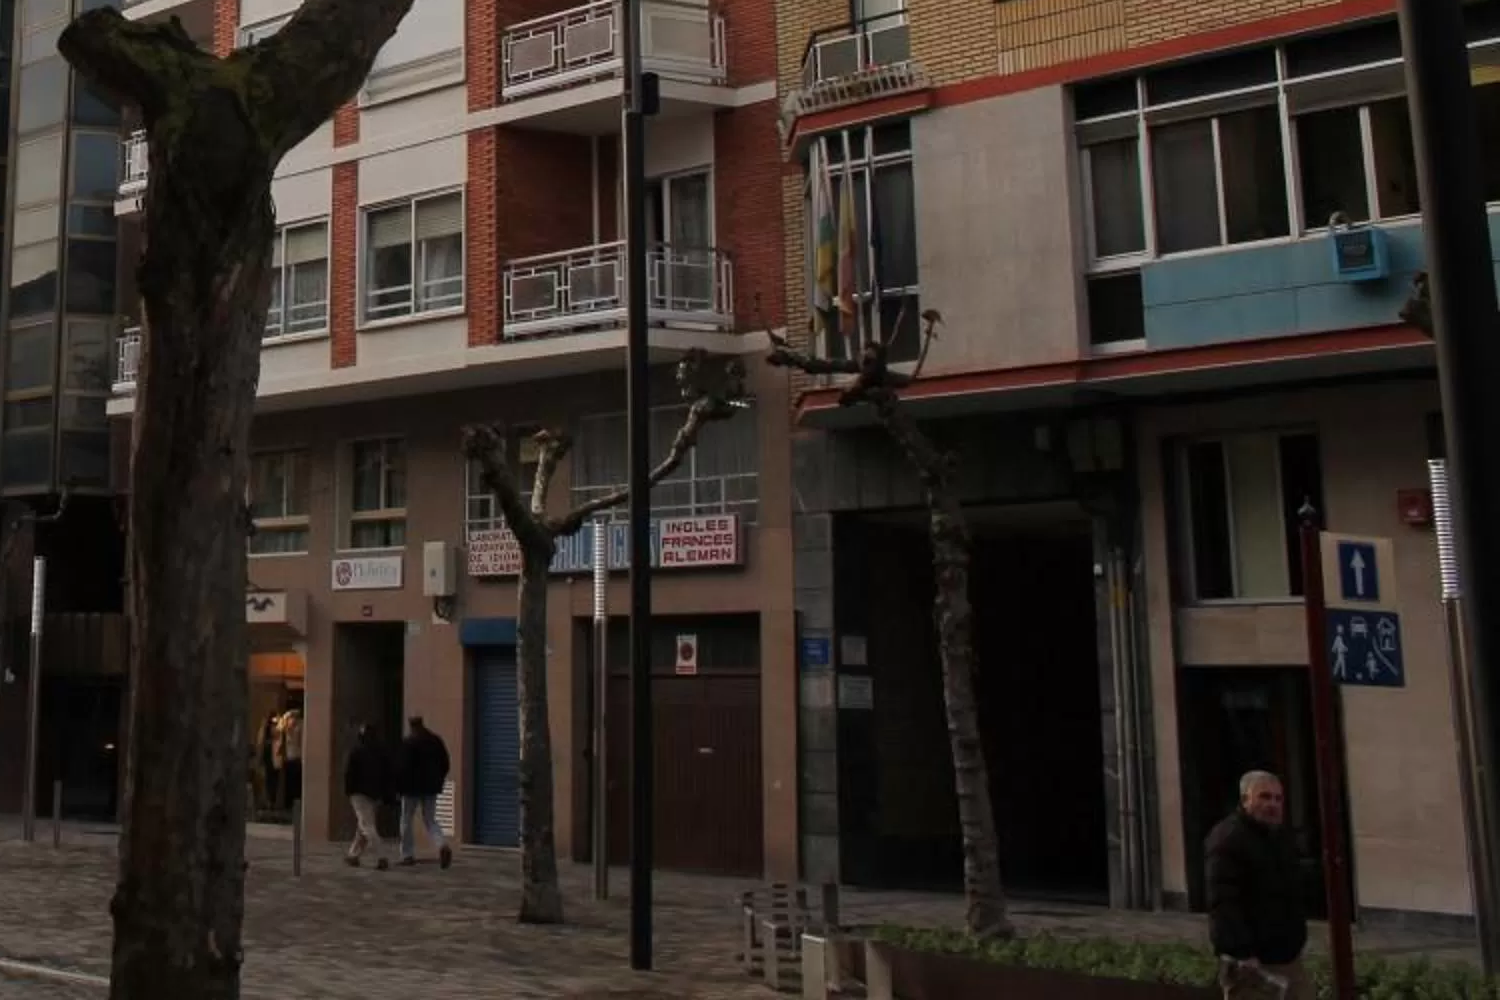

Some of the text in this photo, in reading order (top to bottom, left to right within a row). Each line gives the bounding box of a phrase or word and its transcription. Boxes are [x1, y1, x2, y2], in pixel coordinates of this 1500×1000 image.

[665, 519, 729, 533] INGLES
[662, 533, 733, 548] FRANCES
[663, 547, 732, 564] ALEMAN
